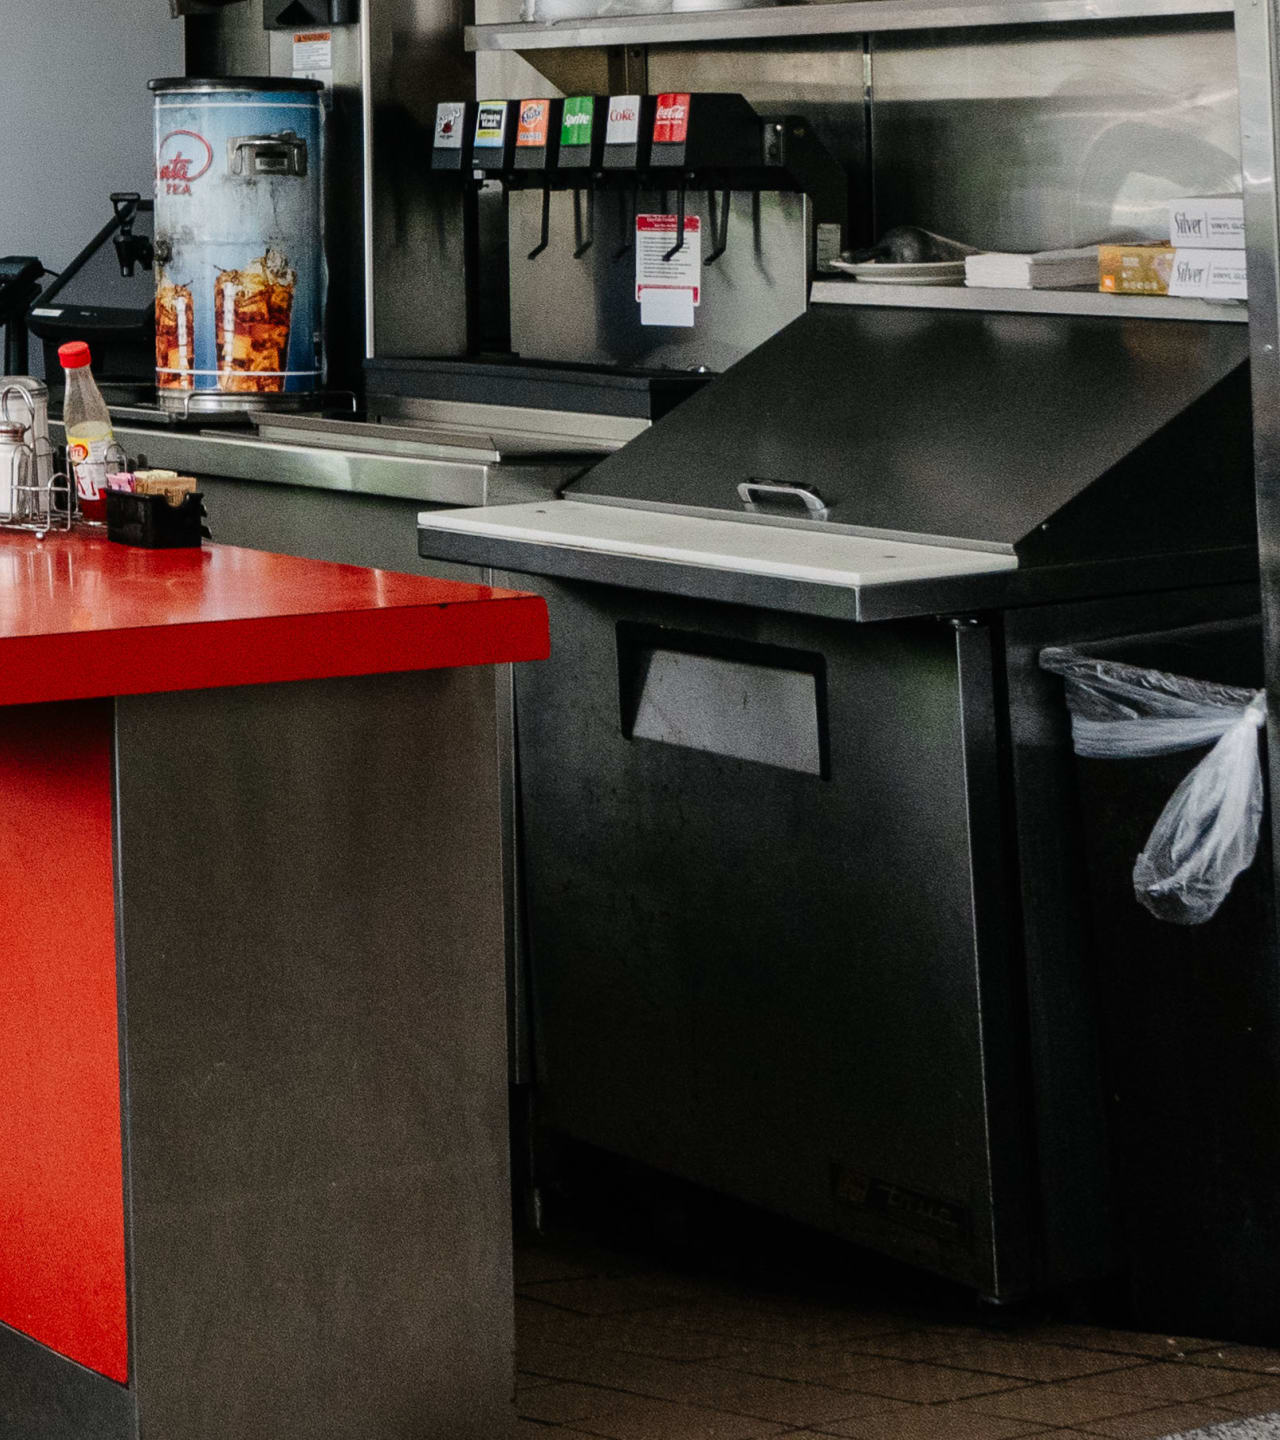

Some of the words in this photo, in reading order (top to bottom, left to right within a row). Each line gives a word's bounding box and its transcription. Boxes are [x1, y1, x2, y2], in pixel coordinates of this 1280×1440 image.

[564, 113, 591, 128] Sprite
[609, 109, 635, 122] Coke
[166, 183, 192, 196] TEA
[1174, 211, 1203, 236] Silver
[1177, 262, 1205, 284] Silver
